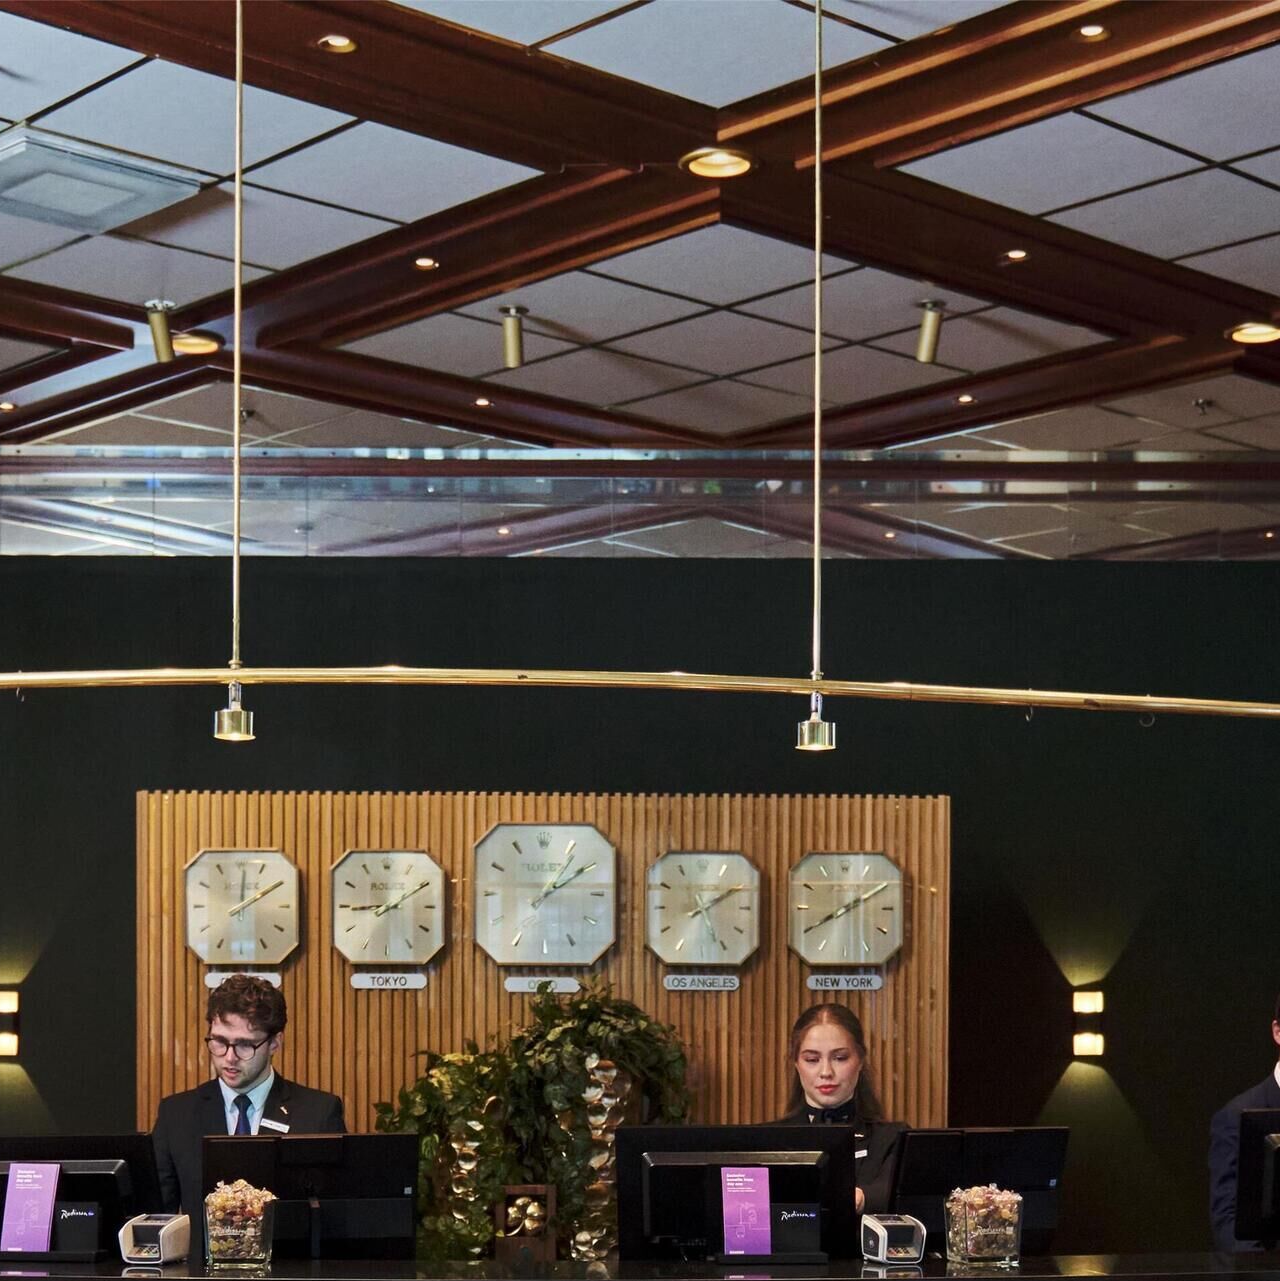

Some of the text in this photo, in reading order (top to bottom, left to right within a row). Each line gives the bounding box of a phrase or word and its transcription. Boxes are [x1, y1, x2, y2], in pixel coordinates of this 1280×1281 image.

[370, 976, 408, 987] TOKYO
[667, 977, 736, 989] LOS ANGELES
[815, 977, 874, 988] NEW YORK
